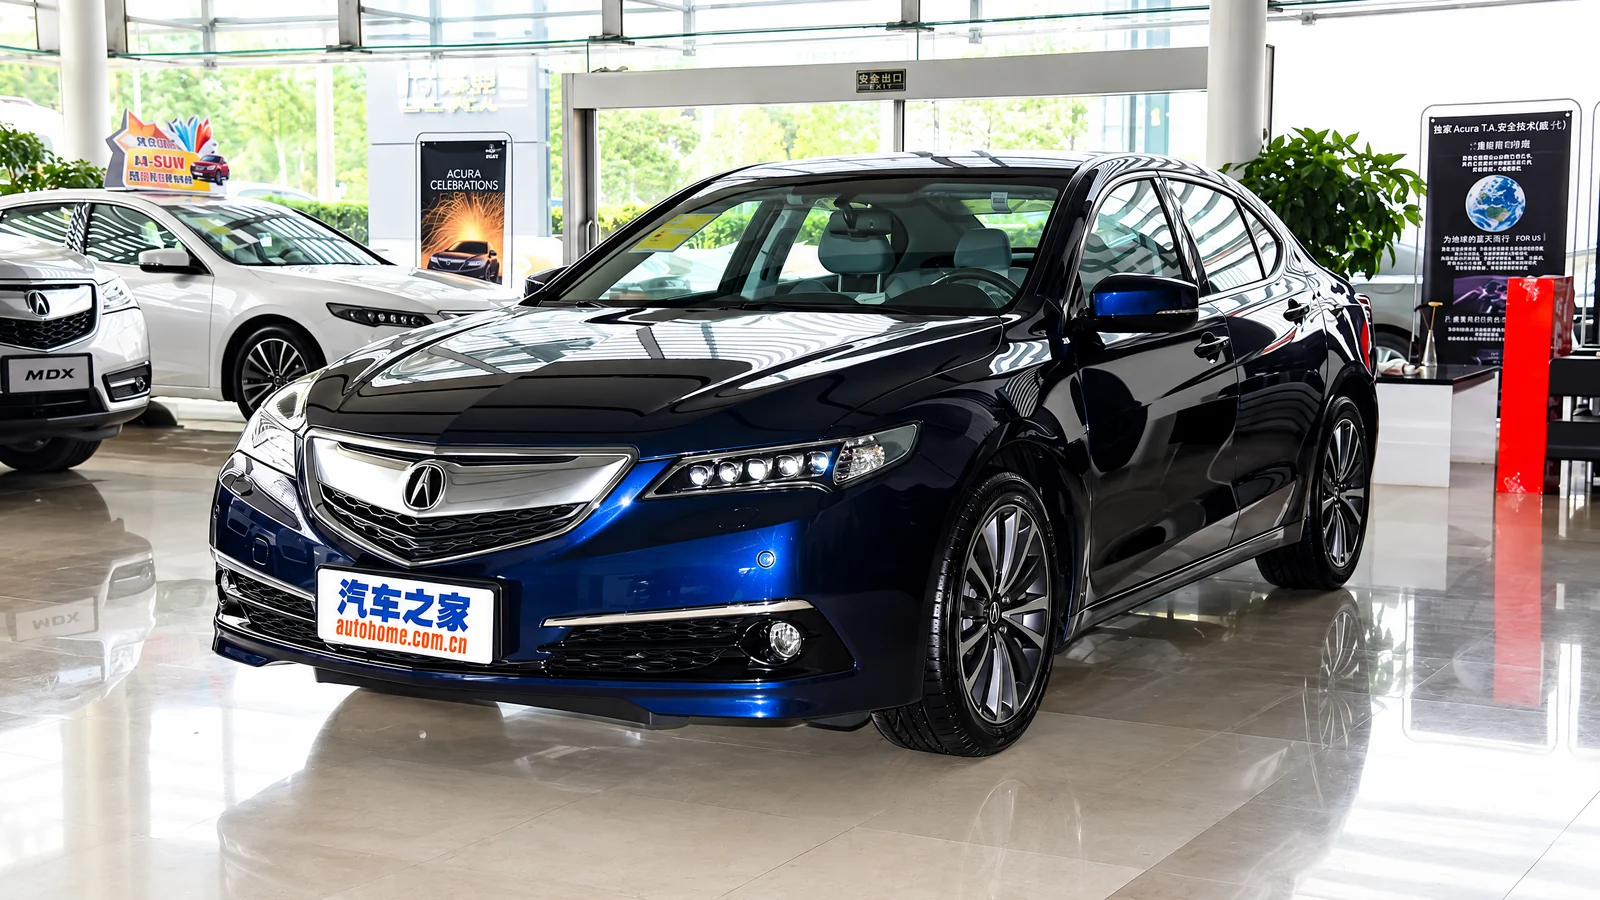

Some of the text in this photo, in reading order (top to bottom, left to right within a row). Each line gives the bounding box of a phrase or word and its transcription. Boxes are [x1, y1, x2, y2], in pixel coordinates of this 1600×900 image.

[859, 73, 902, 84] 安全出口
[1453, 124, 1480, 133] Acura
[446, 169, 482, 179] ACURA
[430, 180, 499, 191] CELEBRATIONS
[25, 368, 75, 381] MDX
[337, 578, 471, 633] 汽车之家
[335, 618, 468, 655] autohome.com.cn
